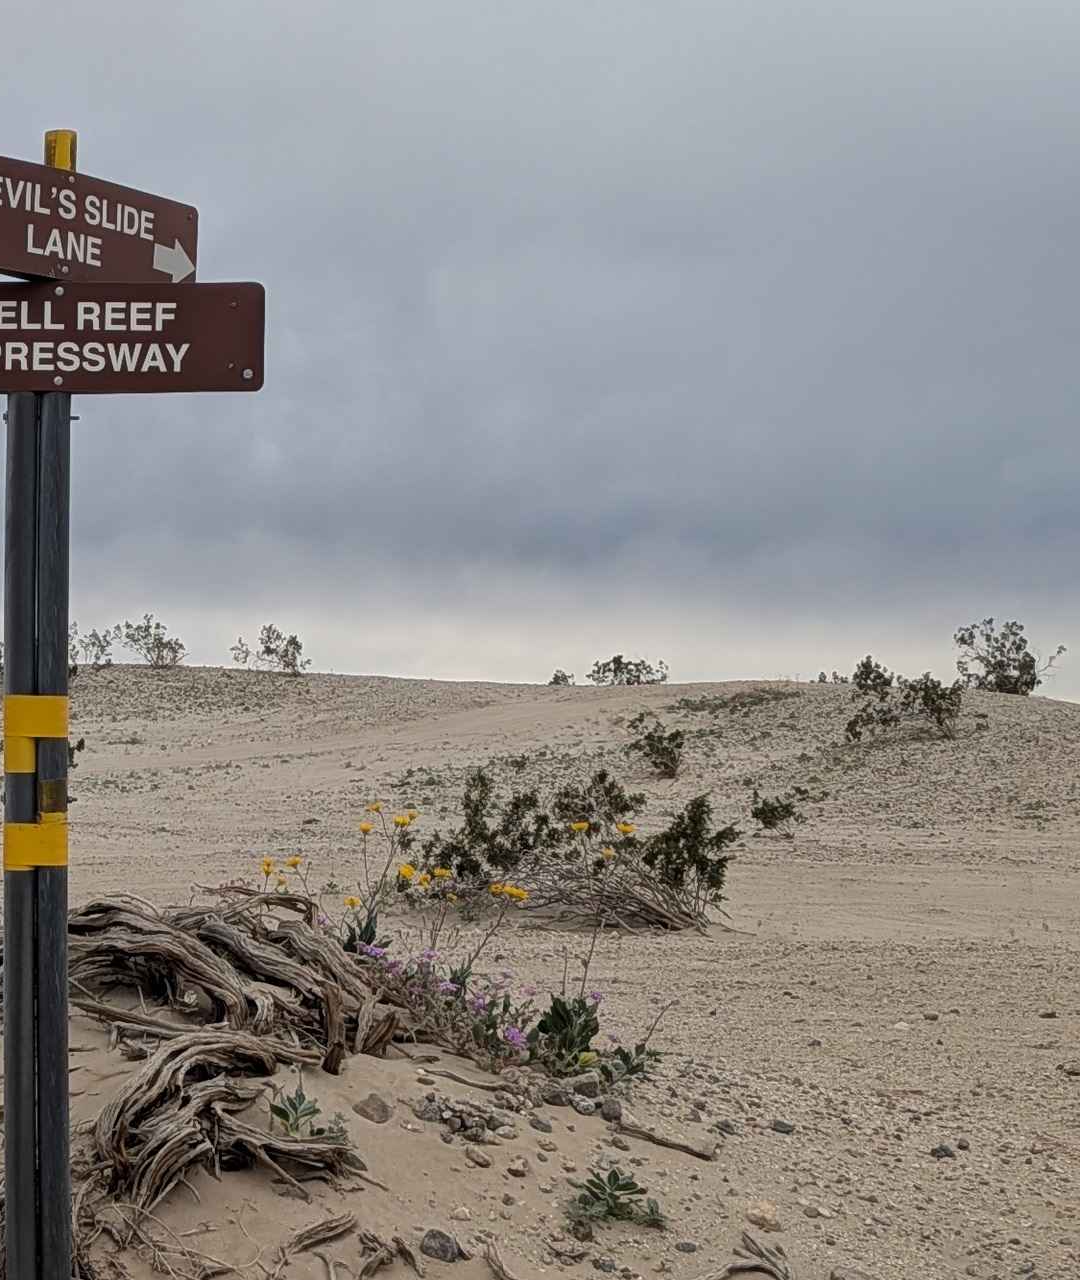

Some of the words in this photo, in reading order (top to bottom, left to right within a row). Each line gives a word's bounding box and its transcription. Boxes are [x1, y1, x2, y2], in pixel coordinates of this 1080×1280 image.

[84, 195, 155, 241] SLIDE
[26, 223, 102, 267] LANE
[77, 301, 177, 332] REEF
